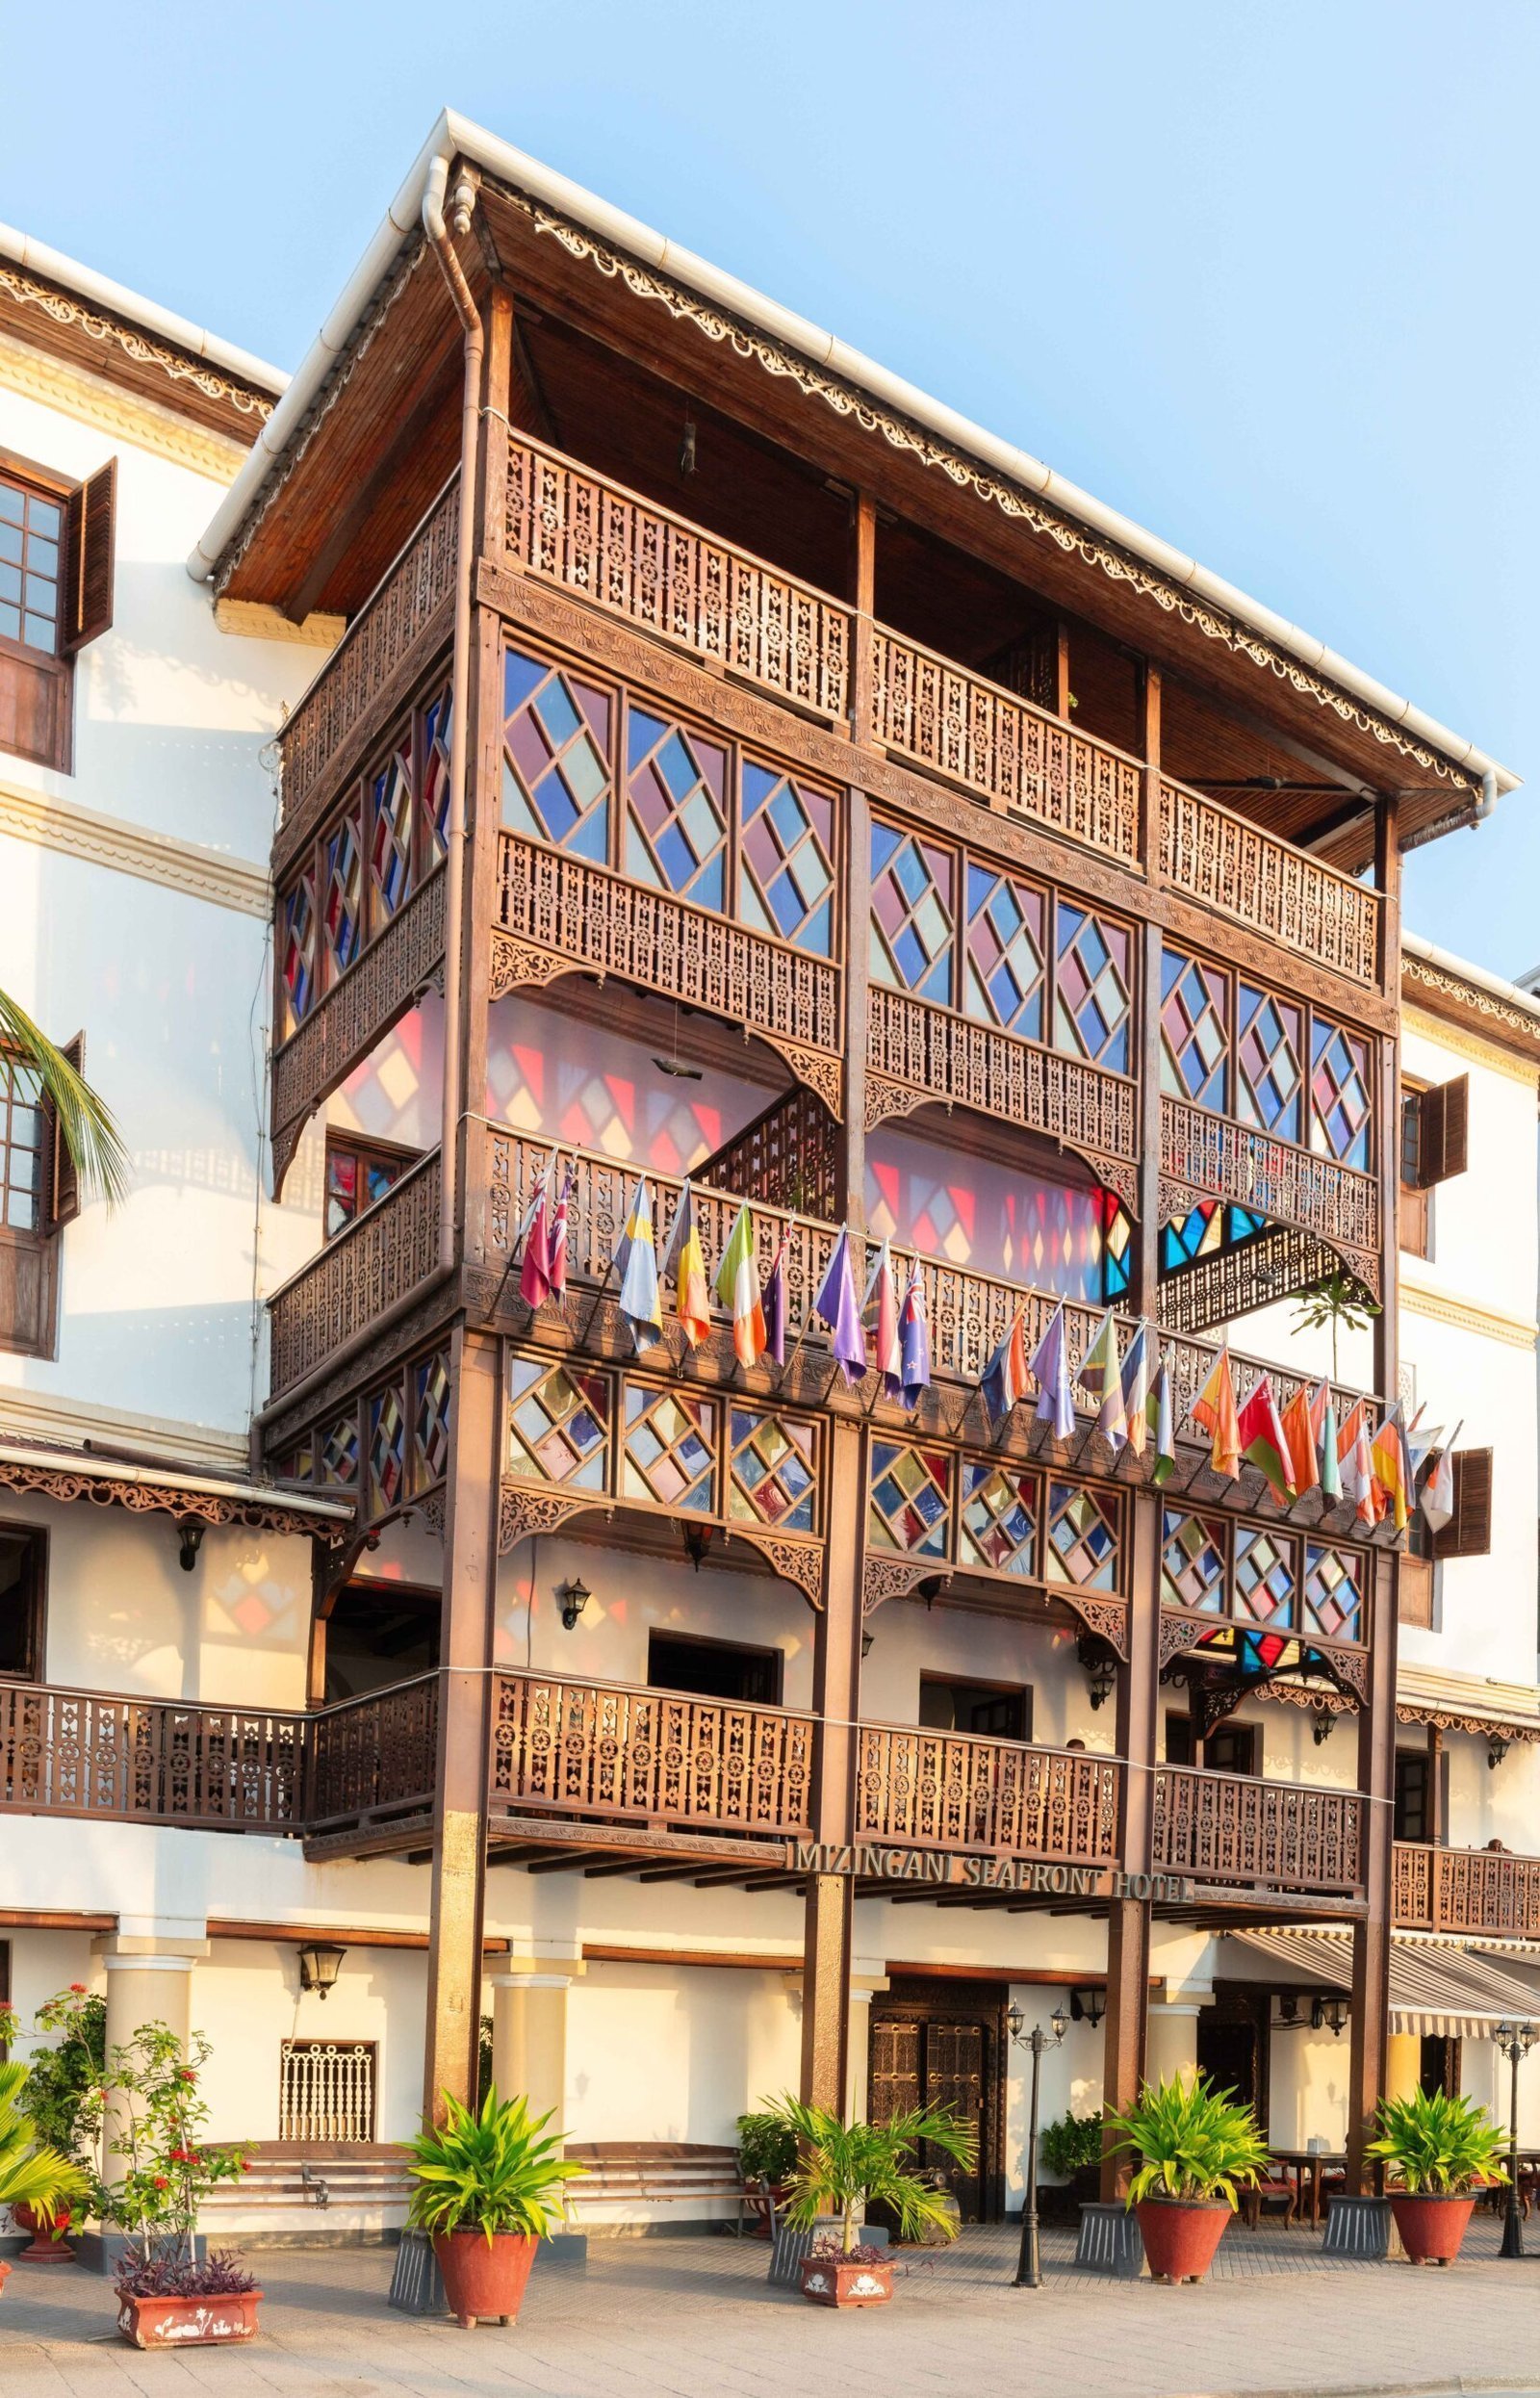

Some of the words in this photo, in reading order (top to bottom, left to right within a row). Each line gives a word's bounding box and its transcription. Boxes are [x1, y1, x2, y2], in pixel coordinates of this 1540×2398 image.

[795, 1843, 952, 1882] MIZINGANI
[963, 1858, 1103, 1895] SEAFRONT
[1114, 1871, 1194, 1903] HOTEL
